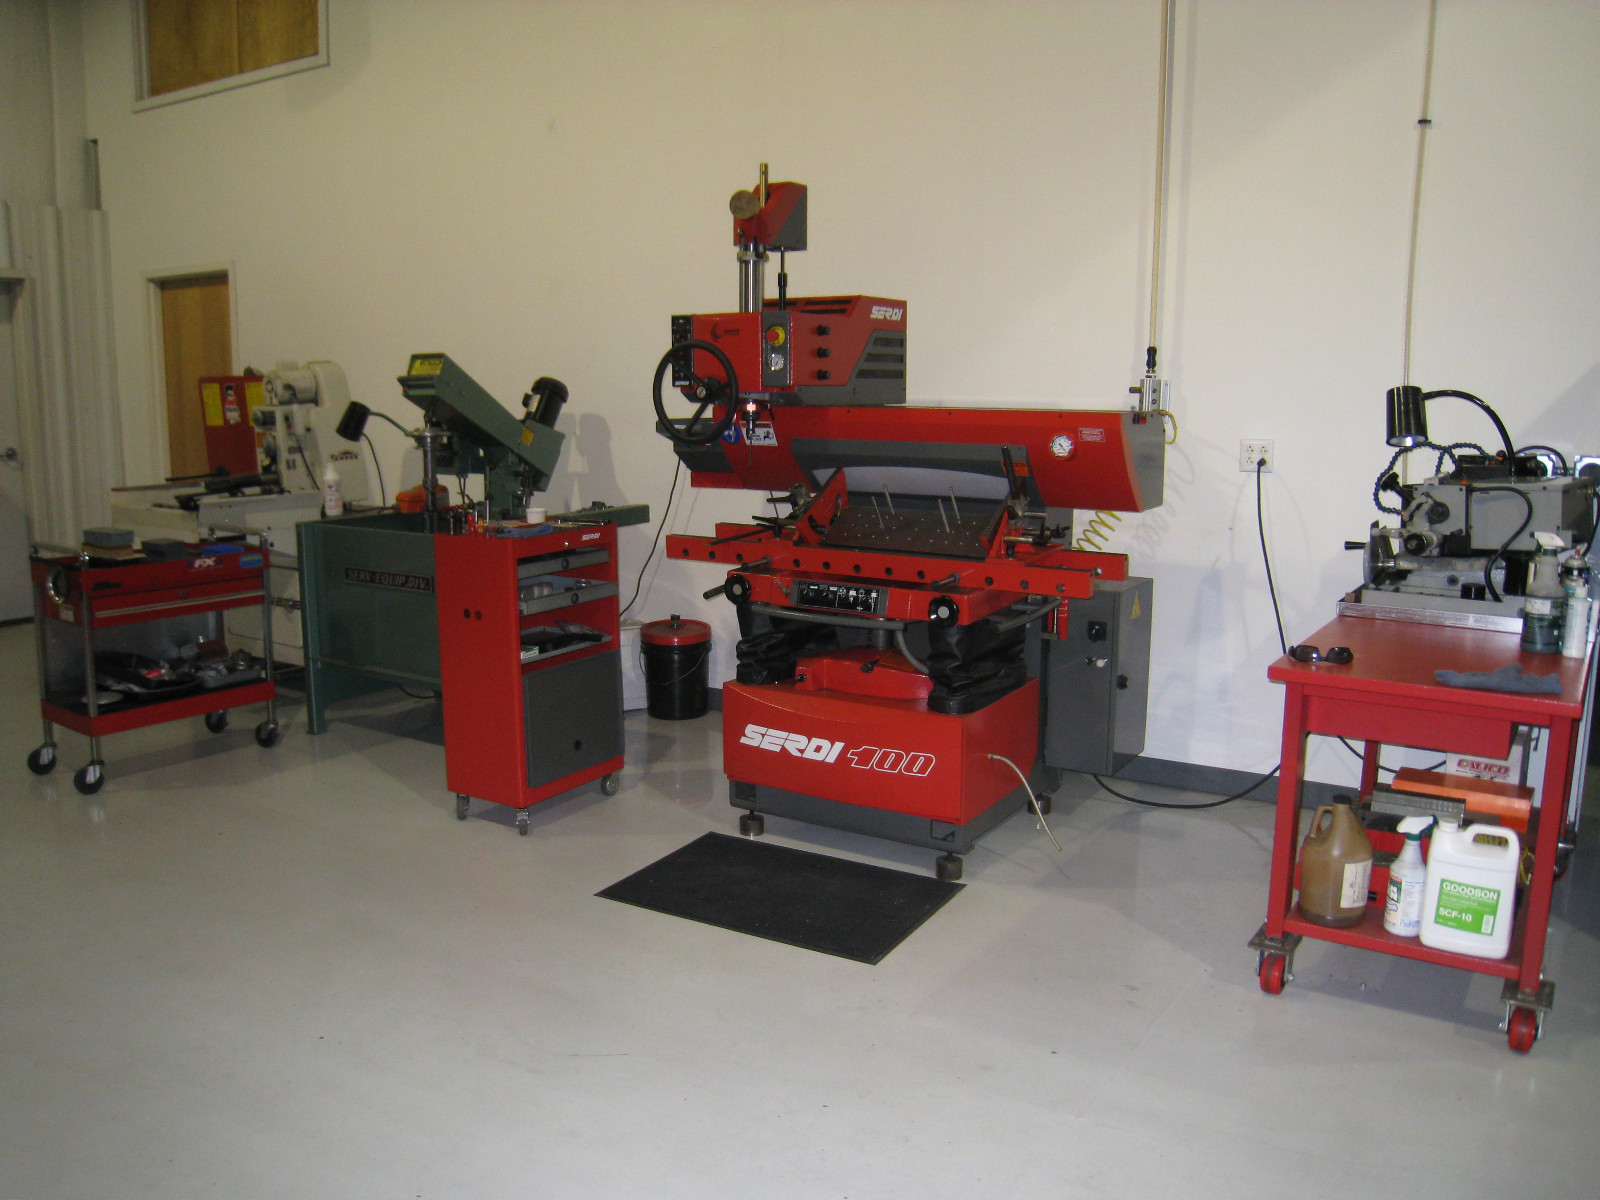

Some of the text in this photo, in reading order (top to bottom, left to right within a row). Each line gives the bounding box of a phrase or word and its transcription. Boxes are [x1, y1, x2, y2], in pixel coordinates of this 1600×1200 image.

[870, 305, 903, 321] SERDI
[739, 723, 936, 777] SERDI 100
[1443, 881, 1497, 900] GOODSON
[1438, 907, 1472, 922] SCF-10
